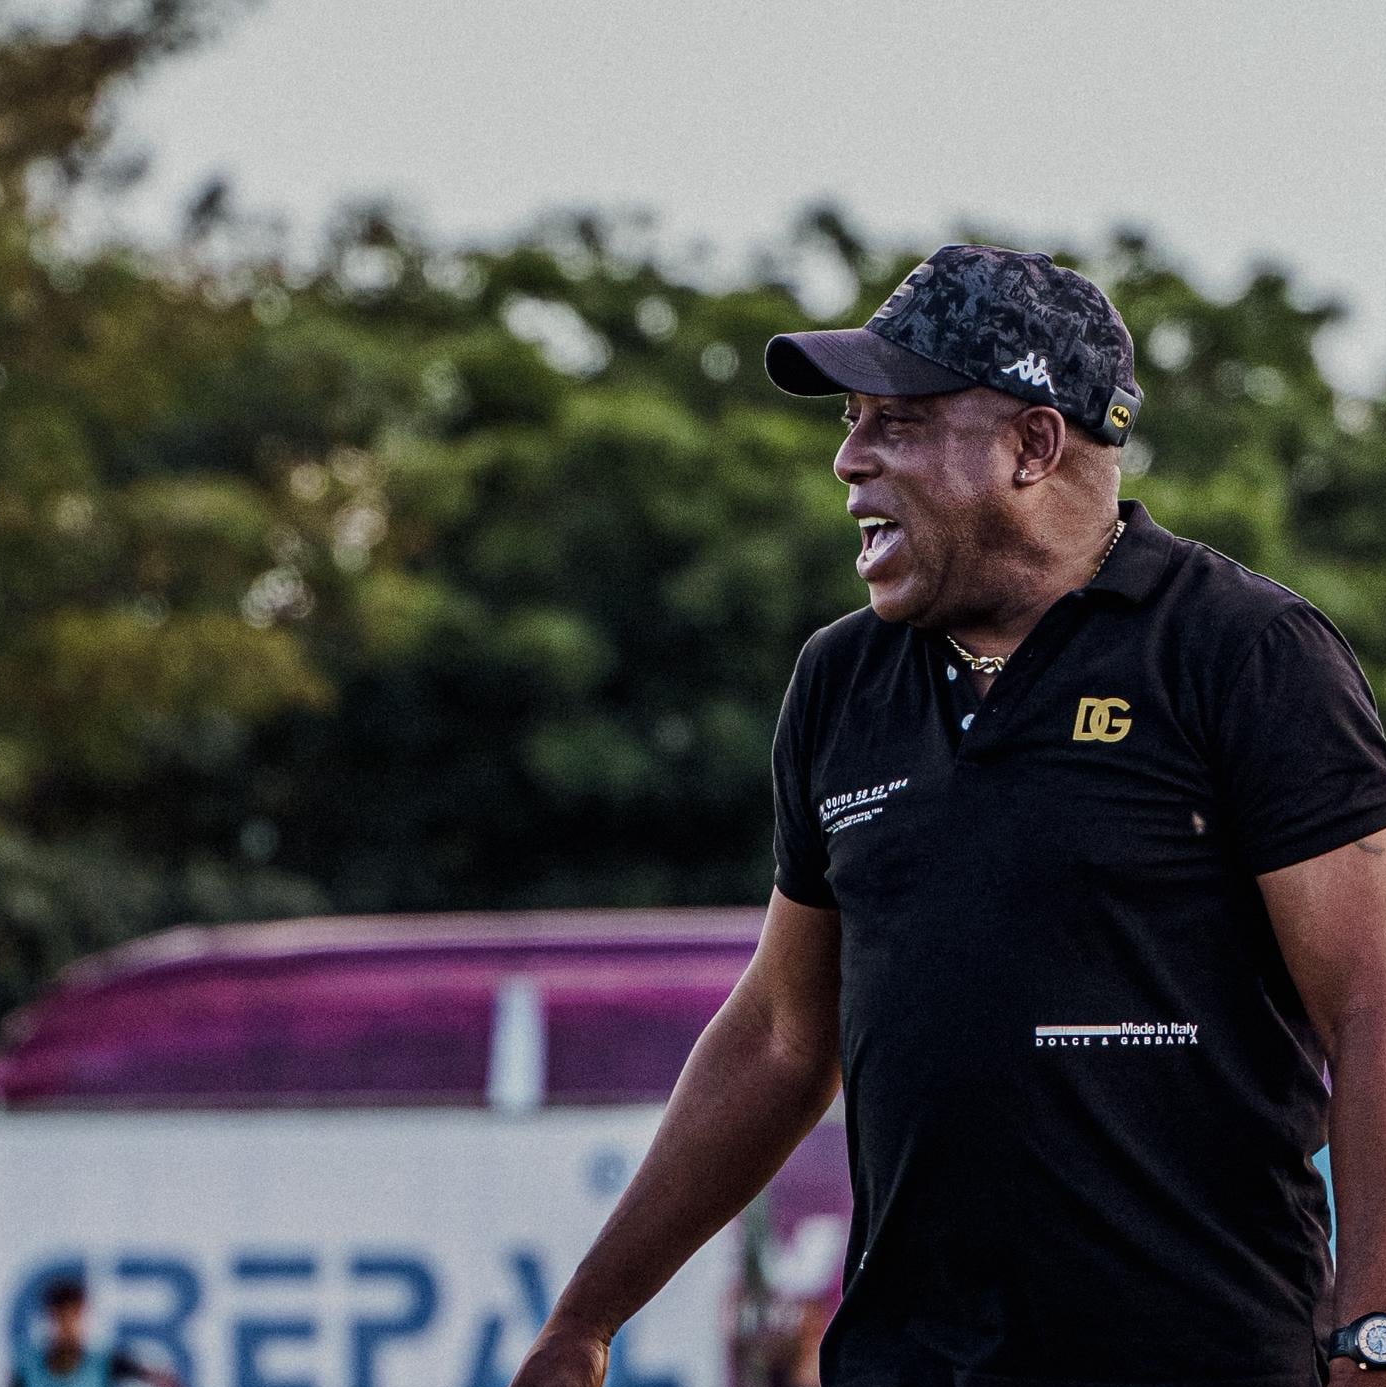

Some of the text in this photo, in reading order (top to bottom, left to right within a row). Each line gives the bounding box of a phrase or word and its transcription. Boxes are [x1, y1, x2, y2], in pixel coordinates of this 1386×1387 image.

[1072, 697, 1132, 743] DG
[1121, 1022, 1198, 1037] Made in Italy
[1035, 1036, 1199, 1047] DOLCE & GABBANA
